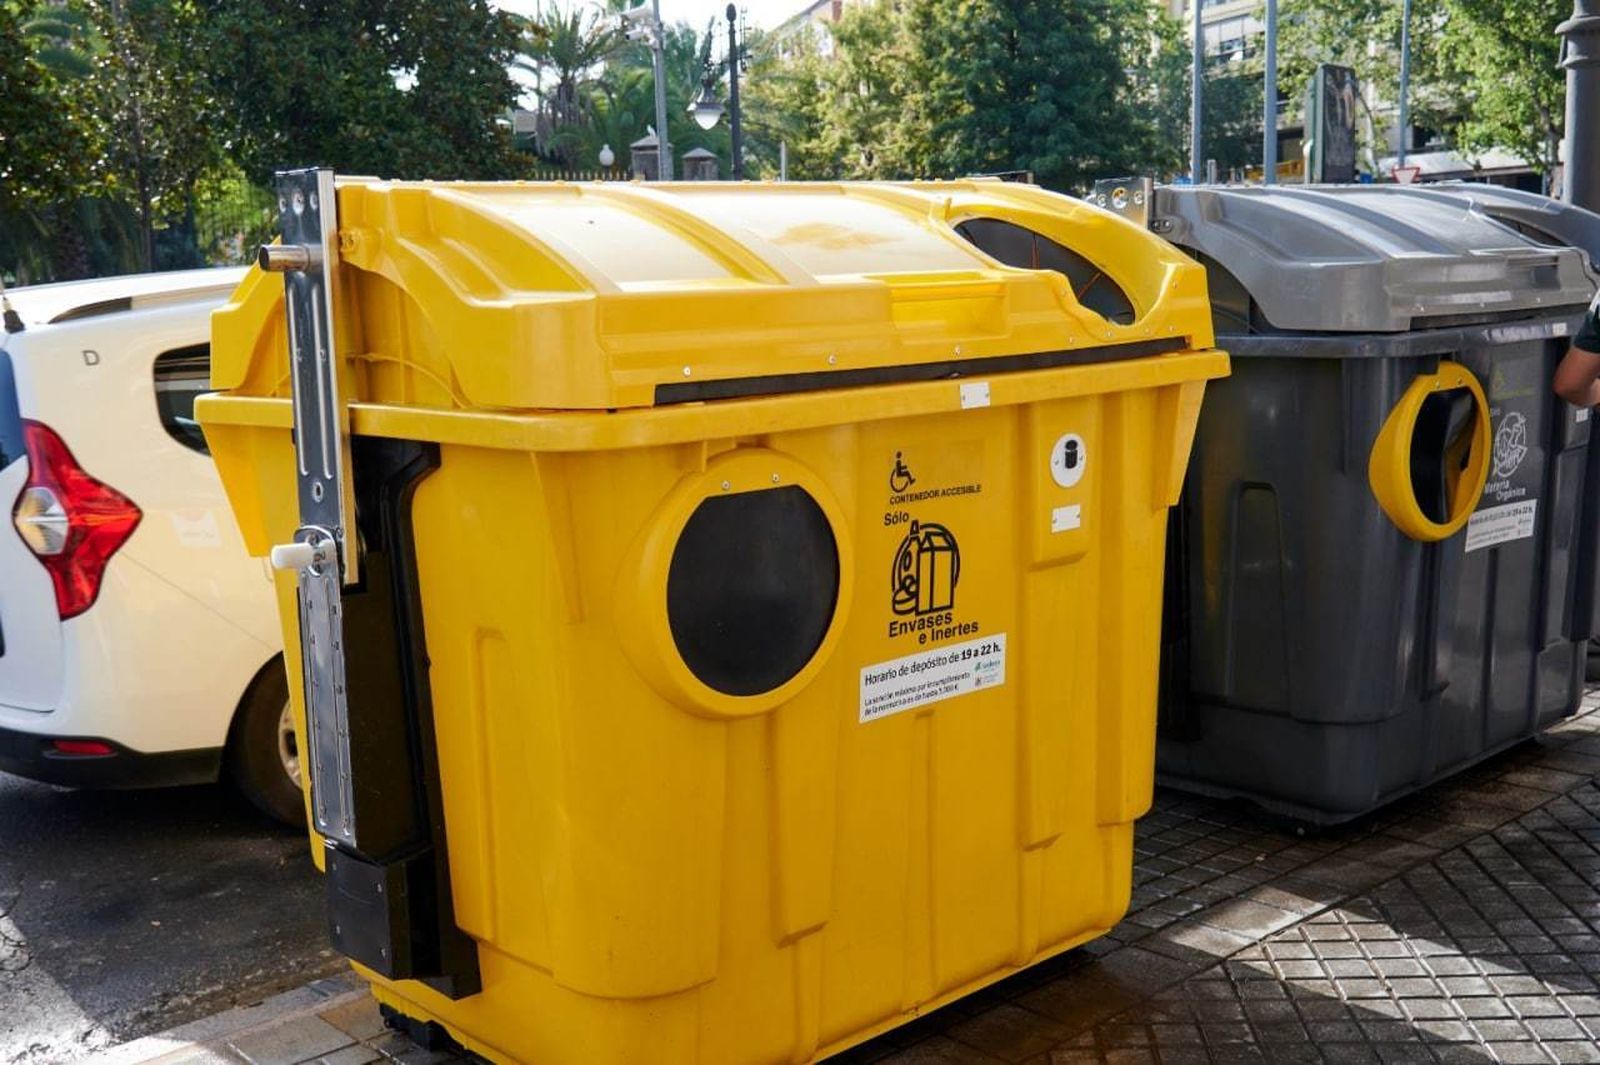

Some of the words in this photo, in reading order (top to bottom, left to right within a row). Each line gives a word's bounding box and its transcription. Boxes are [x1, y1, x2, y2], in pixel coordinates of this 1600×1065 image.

[82, 349, 100, 366] D
[889, 490, 940, 505] CONTENEDOR
[941, 484, 982, 497] ACCESIBLE
[884, 509, 909, 526] Sólo
[889, 611, 953, 638] Envases
[918, 632, 927, 644] e
[931, 621, 979, 641] Inertes
[864, 666, 897, 686] Horario
[898, 663, 909, 677] de
[910, 656, 947, 676] depósito
[949, 652, 960, 664] de
[961, 649, 972, 661] 19
[973, 648, 979, 657] a
[980, 645, 991, 656] 22
[993, 642, 1001, 653] h.
